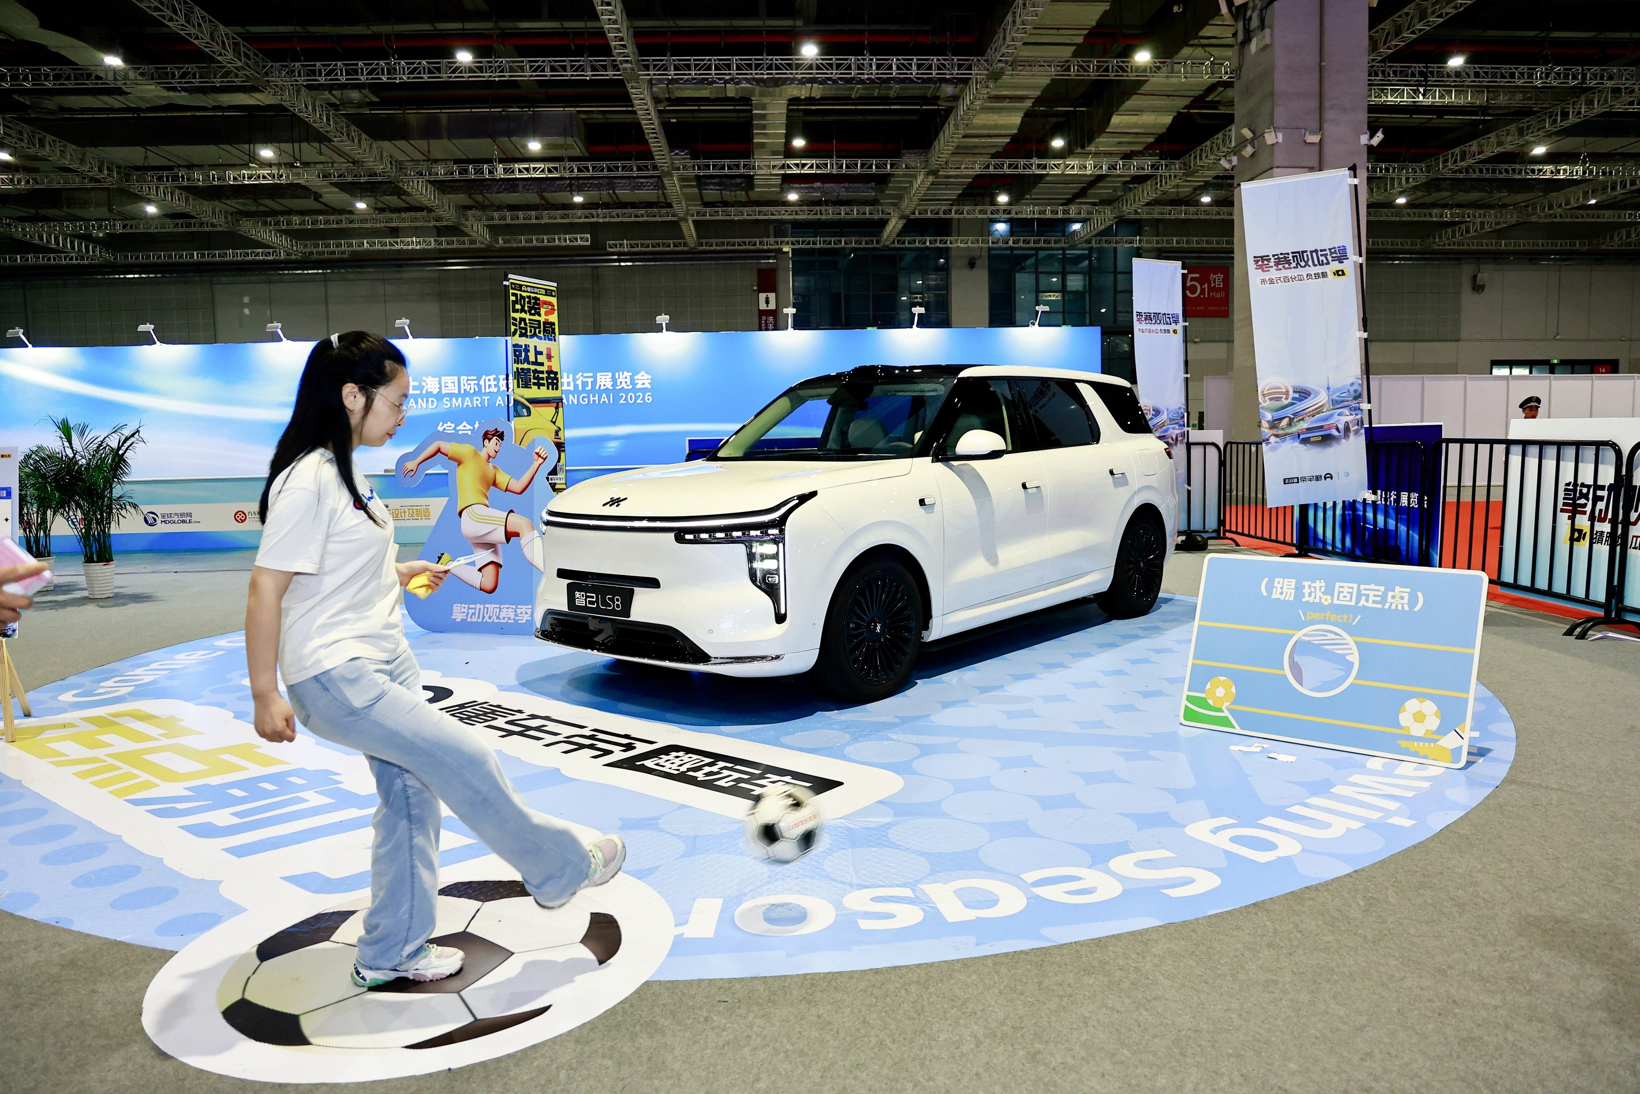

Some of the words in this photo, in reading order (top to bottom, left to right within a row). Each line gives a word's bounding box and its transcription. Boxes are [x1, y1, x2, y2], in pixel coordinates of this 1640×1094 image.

[1186, 273, 1208, 298] 5.1
[1209, 273, 1224, 288] 馆
[511, 316, 557, 342] 没灵感
[514, 366, 559, 391] 懂车帝
[408, 397, 437, 409] AND
[443, 396, 490, 409] SMART
[495, 396, 514, 407] AU
[562, 393, 613, 405] ANGHAI
[619, 392, 652, 404] 2026
[388, 507, 431, 519] 设计及制造
[452, 603, 532, 624] 擎动观赛季
[1306, 611, 1353, 624] perfect!
[57, 650, 227, 702] Game
[438, 700, 658, 760] 懂车帝
